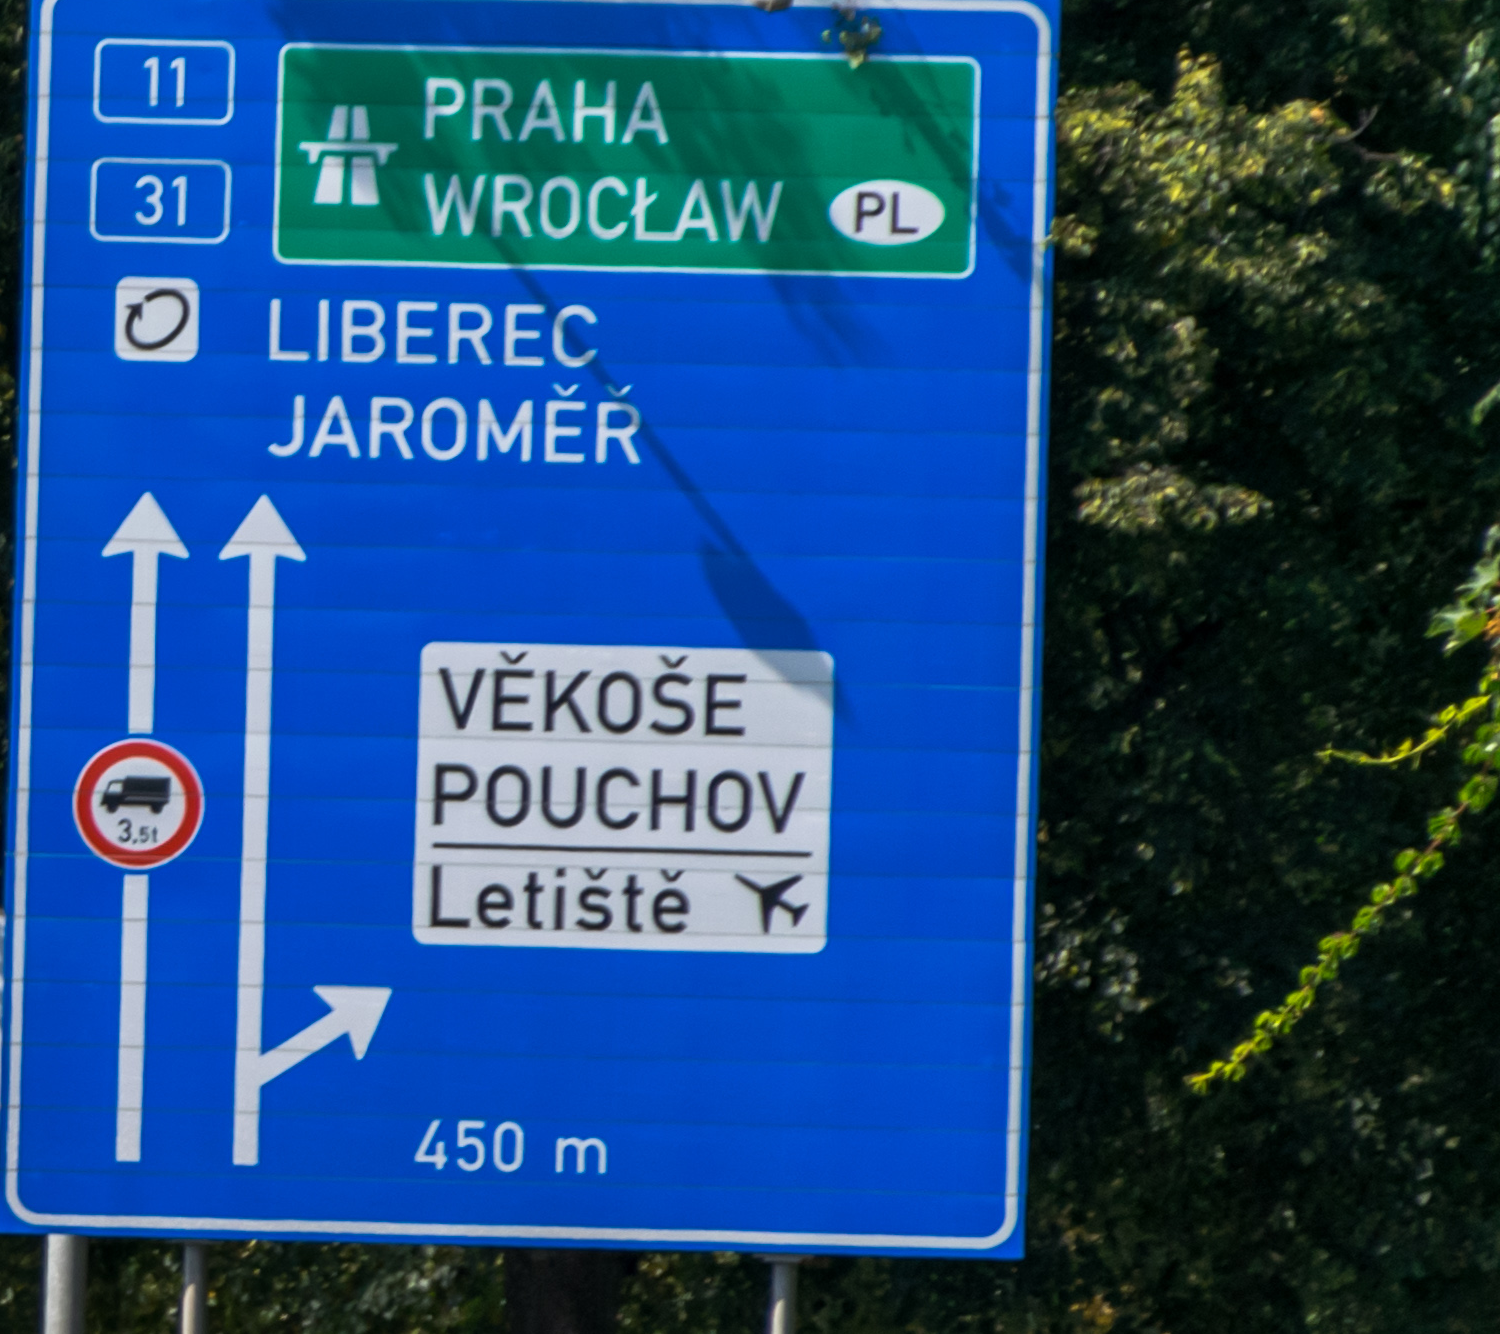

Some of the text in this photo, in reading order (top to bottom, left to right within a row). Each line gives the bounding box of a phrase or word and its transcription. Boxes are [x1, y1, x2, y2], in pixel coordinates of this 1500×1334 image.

[143, 55, 188, 108] 11
[422, 77, 669, 145] PRAHA
[134, 174, 190, 228] 31
[422, 172, 785, 244] WROCŁAW
[853, 190, 920, 236] PL
[269, 298, 599, 369] LIBEREC
[267, 383, 643, 465] JAROMĚŘ
[438, 651, 747, 737] VĚKOŠE
[117, 817, 159, 845] 3,5t
[431, 763, 806, 836] POUCHOV
[428, 865, 691, 935] Letiště
[413, 1119, 610, 1175] 450 m
